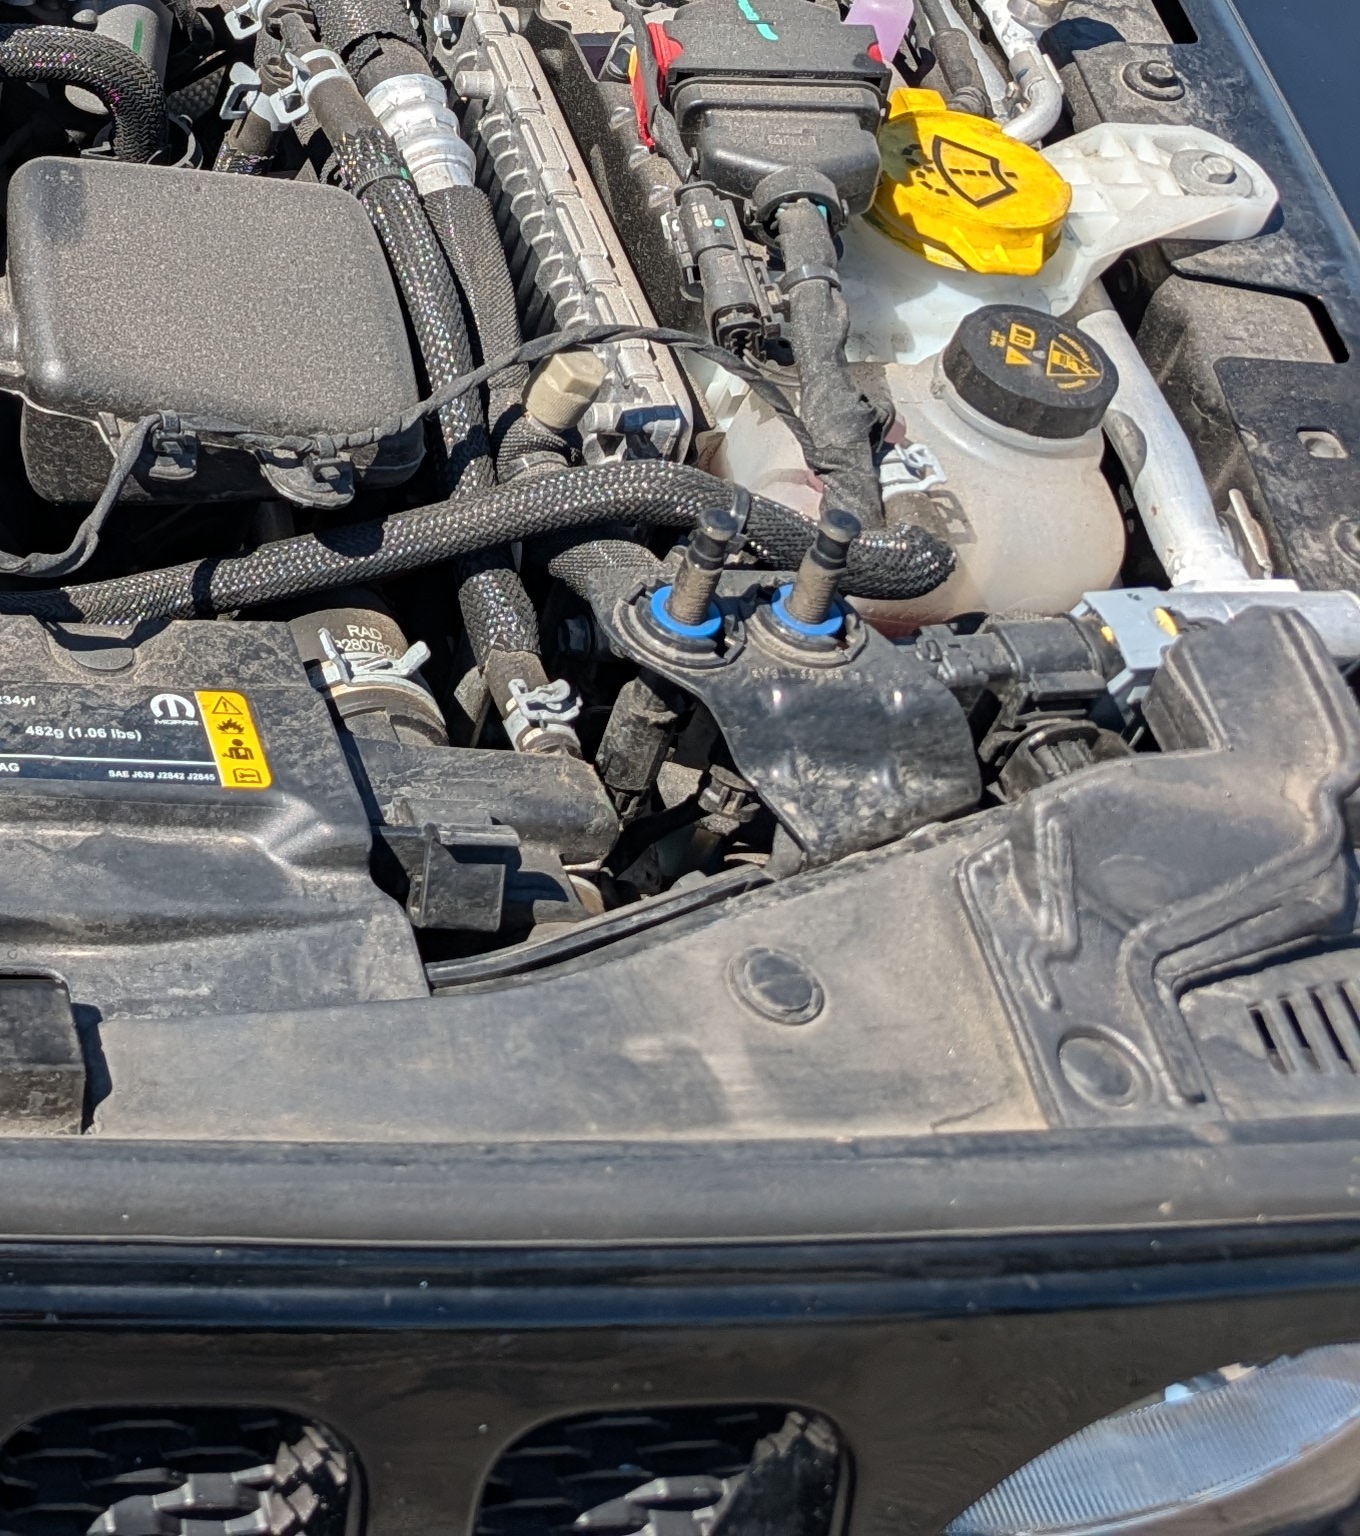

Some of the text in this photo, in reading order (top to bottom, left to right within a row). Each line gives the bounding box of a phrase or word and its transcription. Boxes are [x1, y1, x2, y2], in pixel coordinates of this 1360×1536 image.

[346, 624, 383, 641] RAD
[154, 718, 201, 727] MOPAR
[25, 725, 143, 743] 482g (1.06 lbs)
[108, 769, 130, 778] SAE
[131, 770, 156, 779] J639
